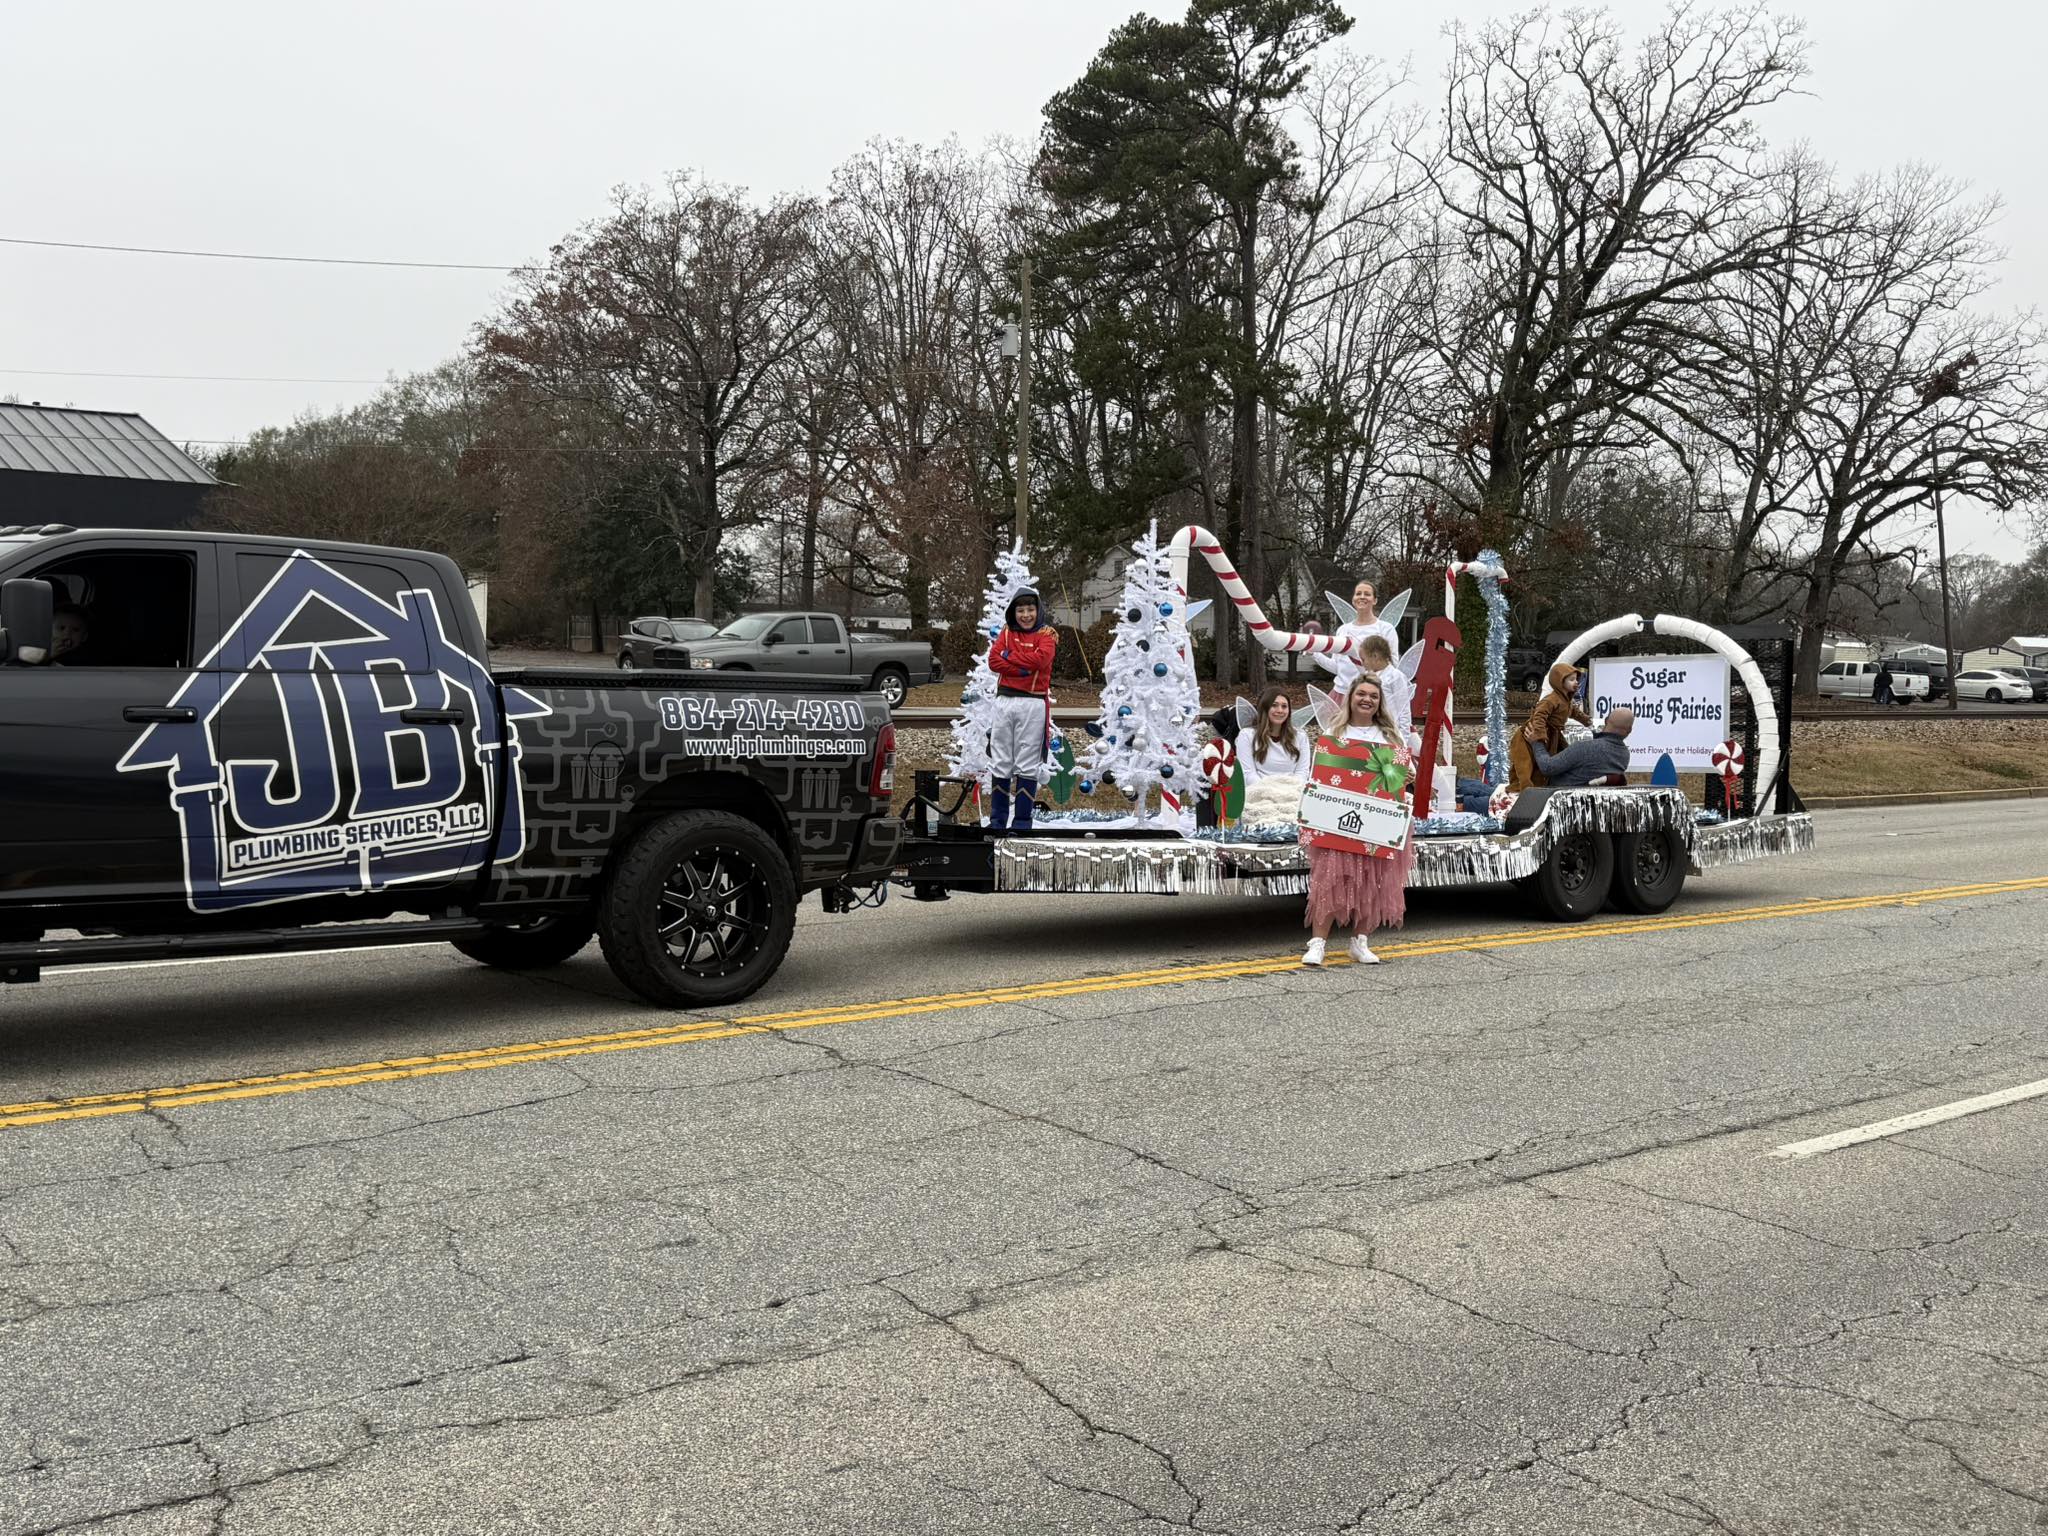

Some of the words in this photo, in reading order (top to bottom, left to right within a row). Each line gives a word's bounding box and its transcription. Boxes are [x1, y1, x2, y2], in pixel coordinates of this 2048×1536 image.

[1630, 667, 1687, 690] Sugar
[660, 697, 865, 731] 864-214-4280
[1667, 696, 1722, 724] Fairies
[225, 645, 467, 833] JB
[685, 735, 866, 758] www.jbplumbingsc.com
[1628, 746, 1646, 754] weet
[1648, 746, 1664, 754] Flow
[1665, 746, 1673, 754] to
[1675, 745, 1686, 754] the
[1308, 788, 1362, 810] Supporting
[1363, 803, 1404, 819] Sponsor
[233, 830, 341, 865] PLUMBING
[345, 813, 446, 846] SERVICES,
[449, 806, 482, 829] LLC
[1342, 815, 1358, 829] JB
